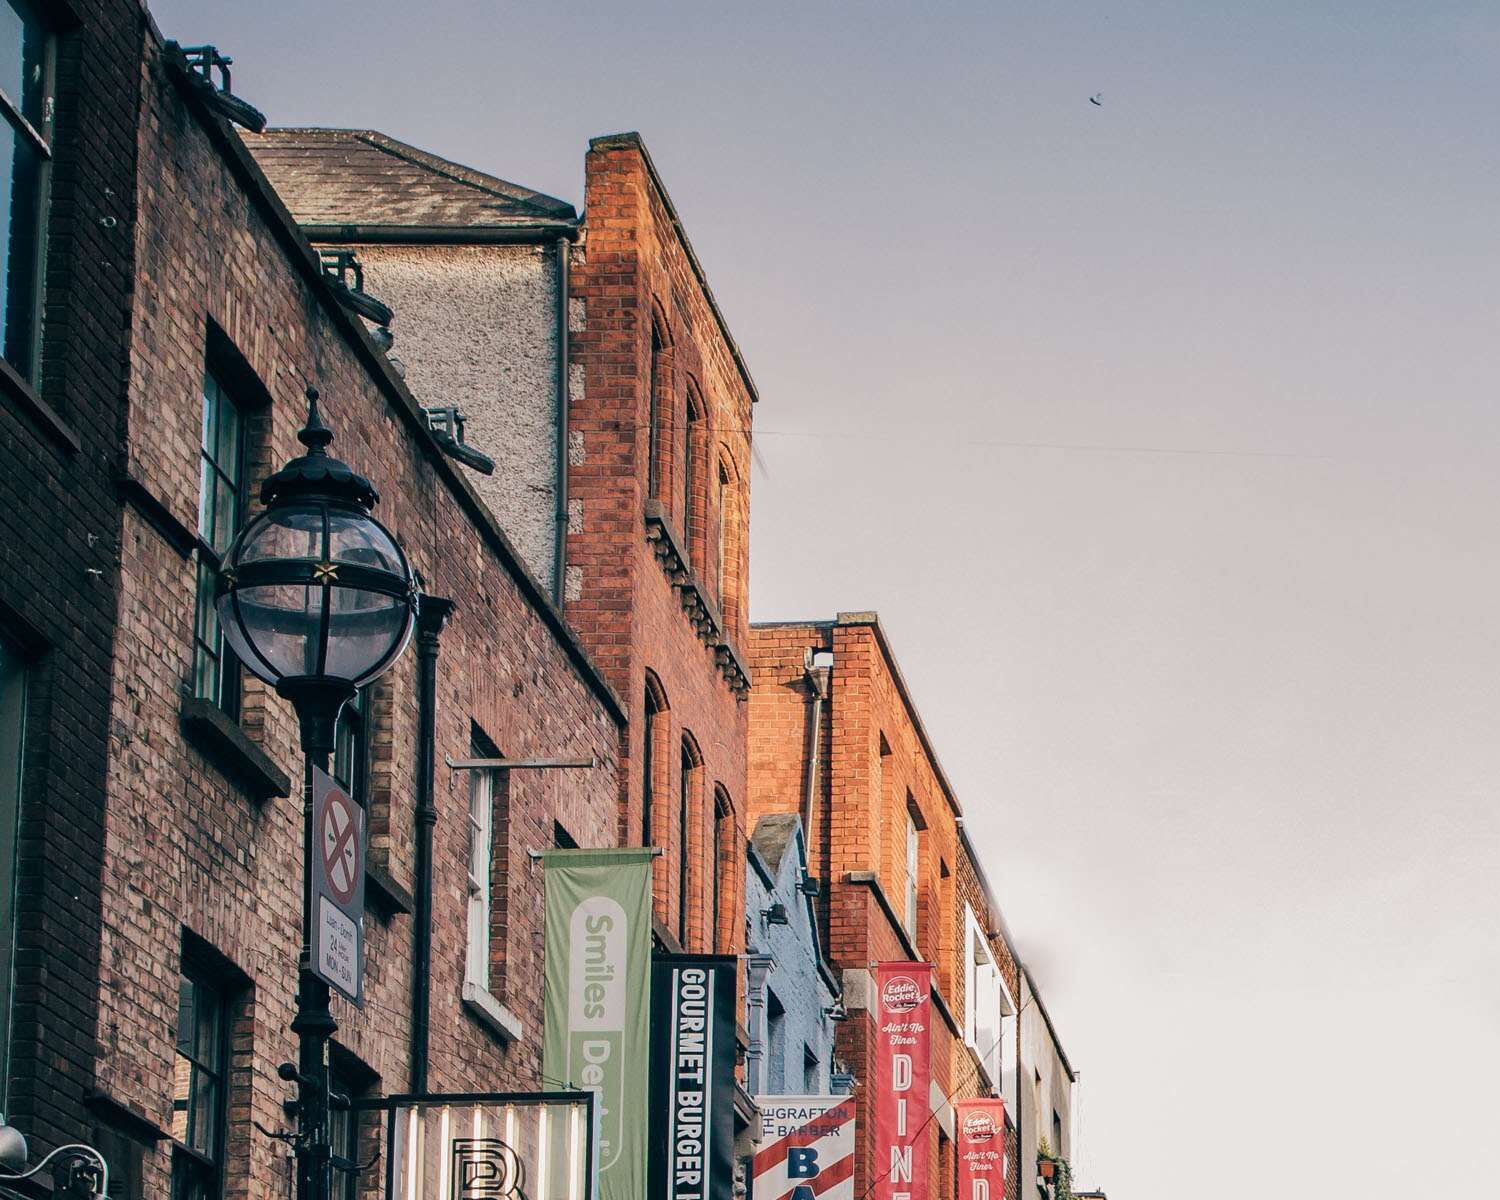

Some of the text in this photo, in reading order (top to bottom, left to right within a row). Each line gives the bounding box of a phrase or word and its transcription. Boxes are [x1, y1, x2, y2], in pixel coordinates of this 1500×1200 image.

[583, 914, 613, 1020] Smiles
[888, 983, 915, 993] Eddie
[676, 968, 706, 1084] GOURMET
[762, 1107, 773, 1136] THE
[775, 1107, 848, 1120] GRAFTON
[675, 1091, 703, 1183] BURGER
[777, 1124, 841, 1137] BARBER
